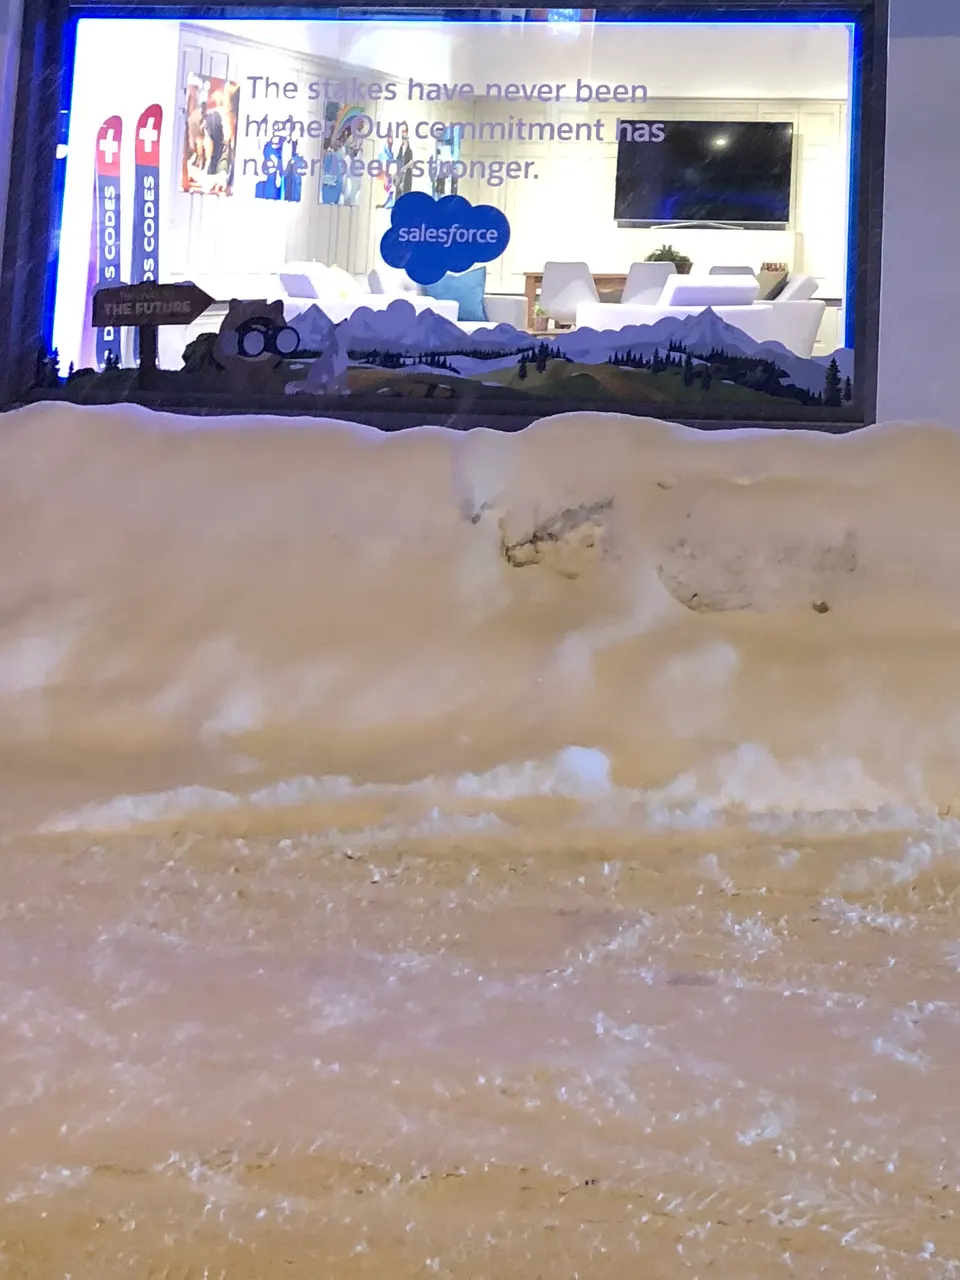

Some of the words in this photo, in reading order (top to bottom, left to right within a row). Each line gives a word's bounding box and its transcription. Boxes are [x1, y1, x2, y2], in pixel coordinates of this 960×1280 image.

[247, 76, 298, 100] The
[308, 77, 397, 101] stakes
[407, 78, 475, 101] have
[485, 82, 567, 103] never
[575, 78, 648, 103] been
[351, 114, 408, 140] Our
[415, 115, 605, 142] commitment
[615, 118, 666, 143] has
[243, 158, 321, 177] never
[330, 152, 403, 178] been
[412, 154, 539, 187] stronger.
[104, 185, 116, 260] CODES
[143, 175, 155, 252] CODES
[398, 223, 498, 248] salesforce
[104, 302, 132, 316] THE
[136, 300, 192, 315] FUTURE
